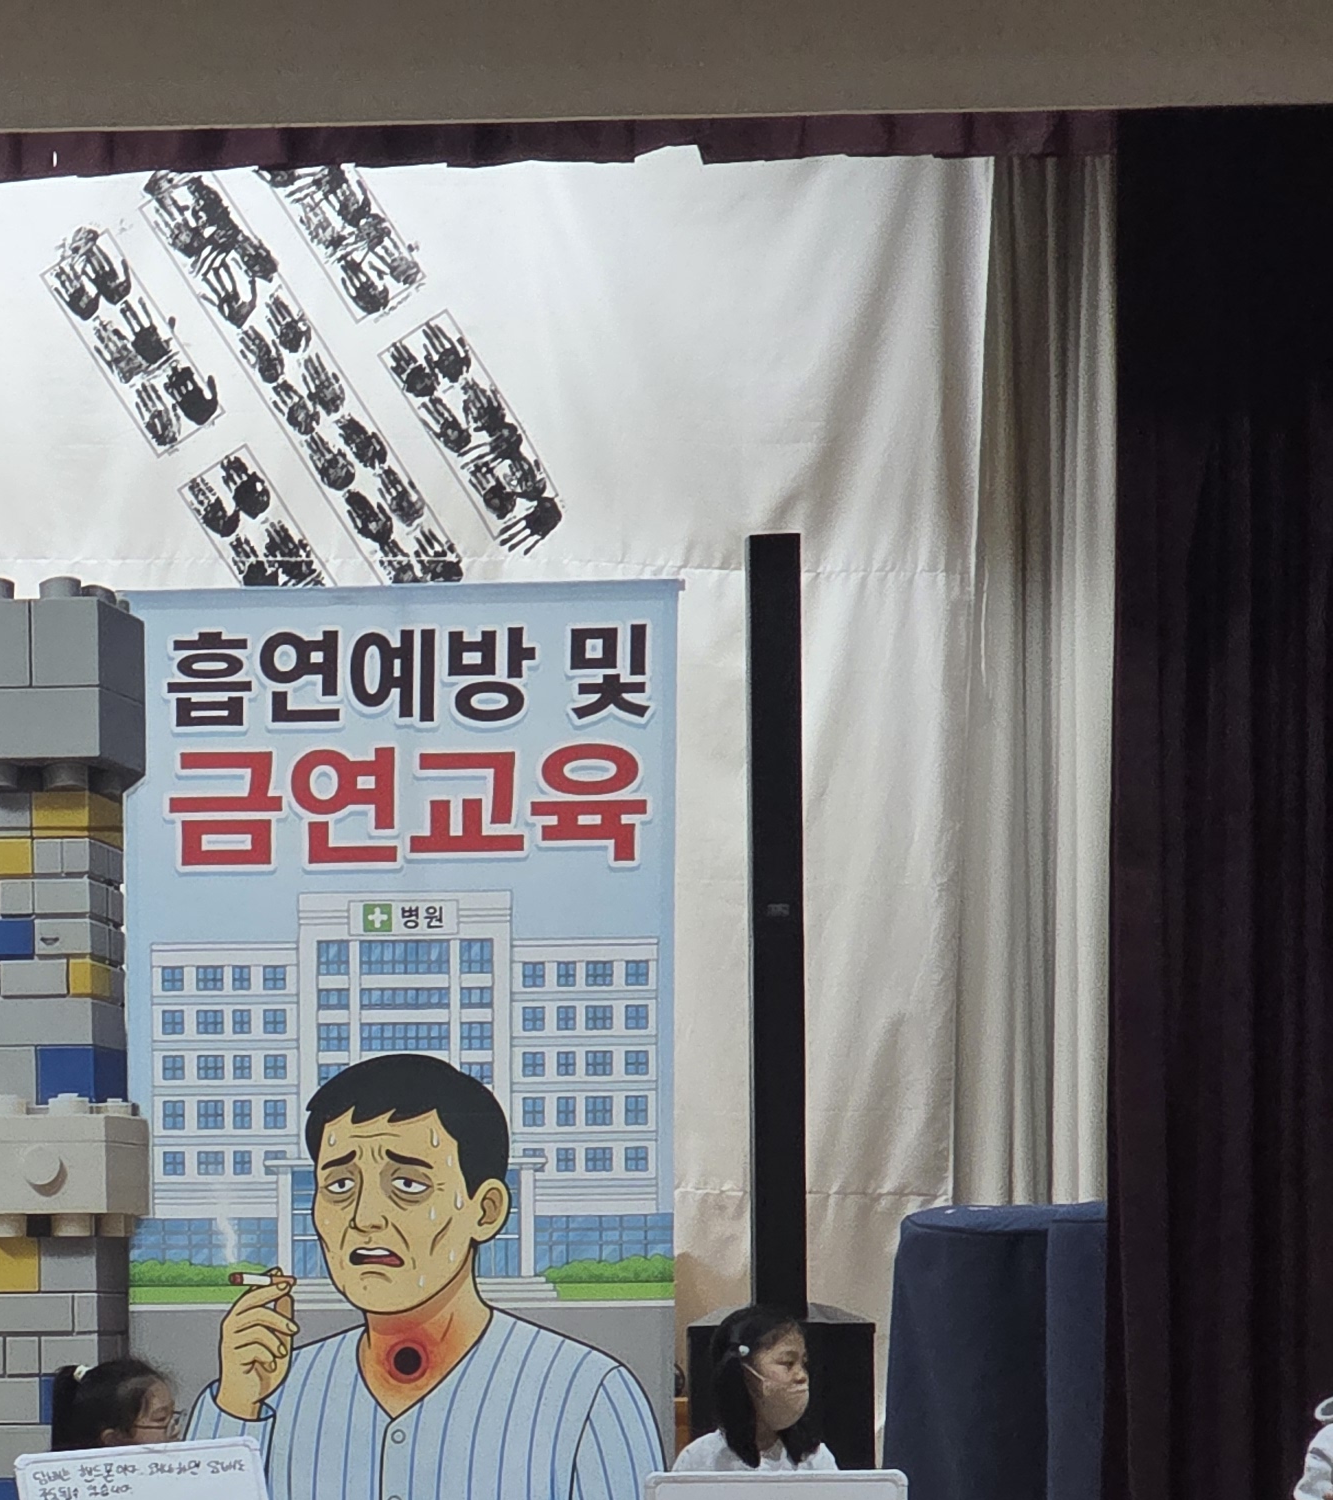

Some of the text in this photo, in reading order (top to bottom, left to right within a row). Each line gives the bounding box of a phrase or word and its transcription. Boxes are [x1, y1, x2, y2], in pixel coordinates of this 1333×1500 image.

[165, 622, 652, 728] 흡연예방 및
[167, 742, 649, 867] 금연교육
[401, 905, 444, 929] 병원
[32, 1467, 72, 1485] 담배는
